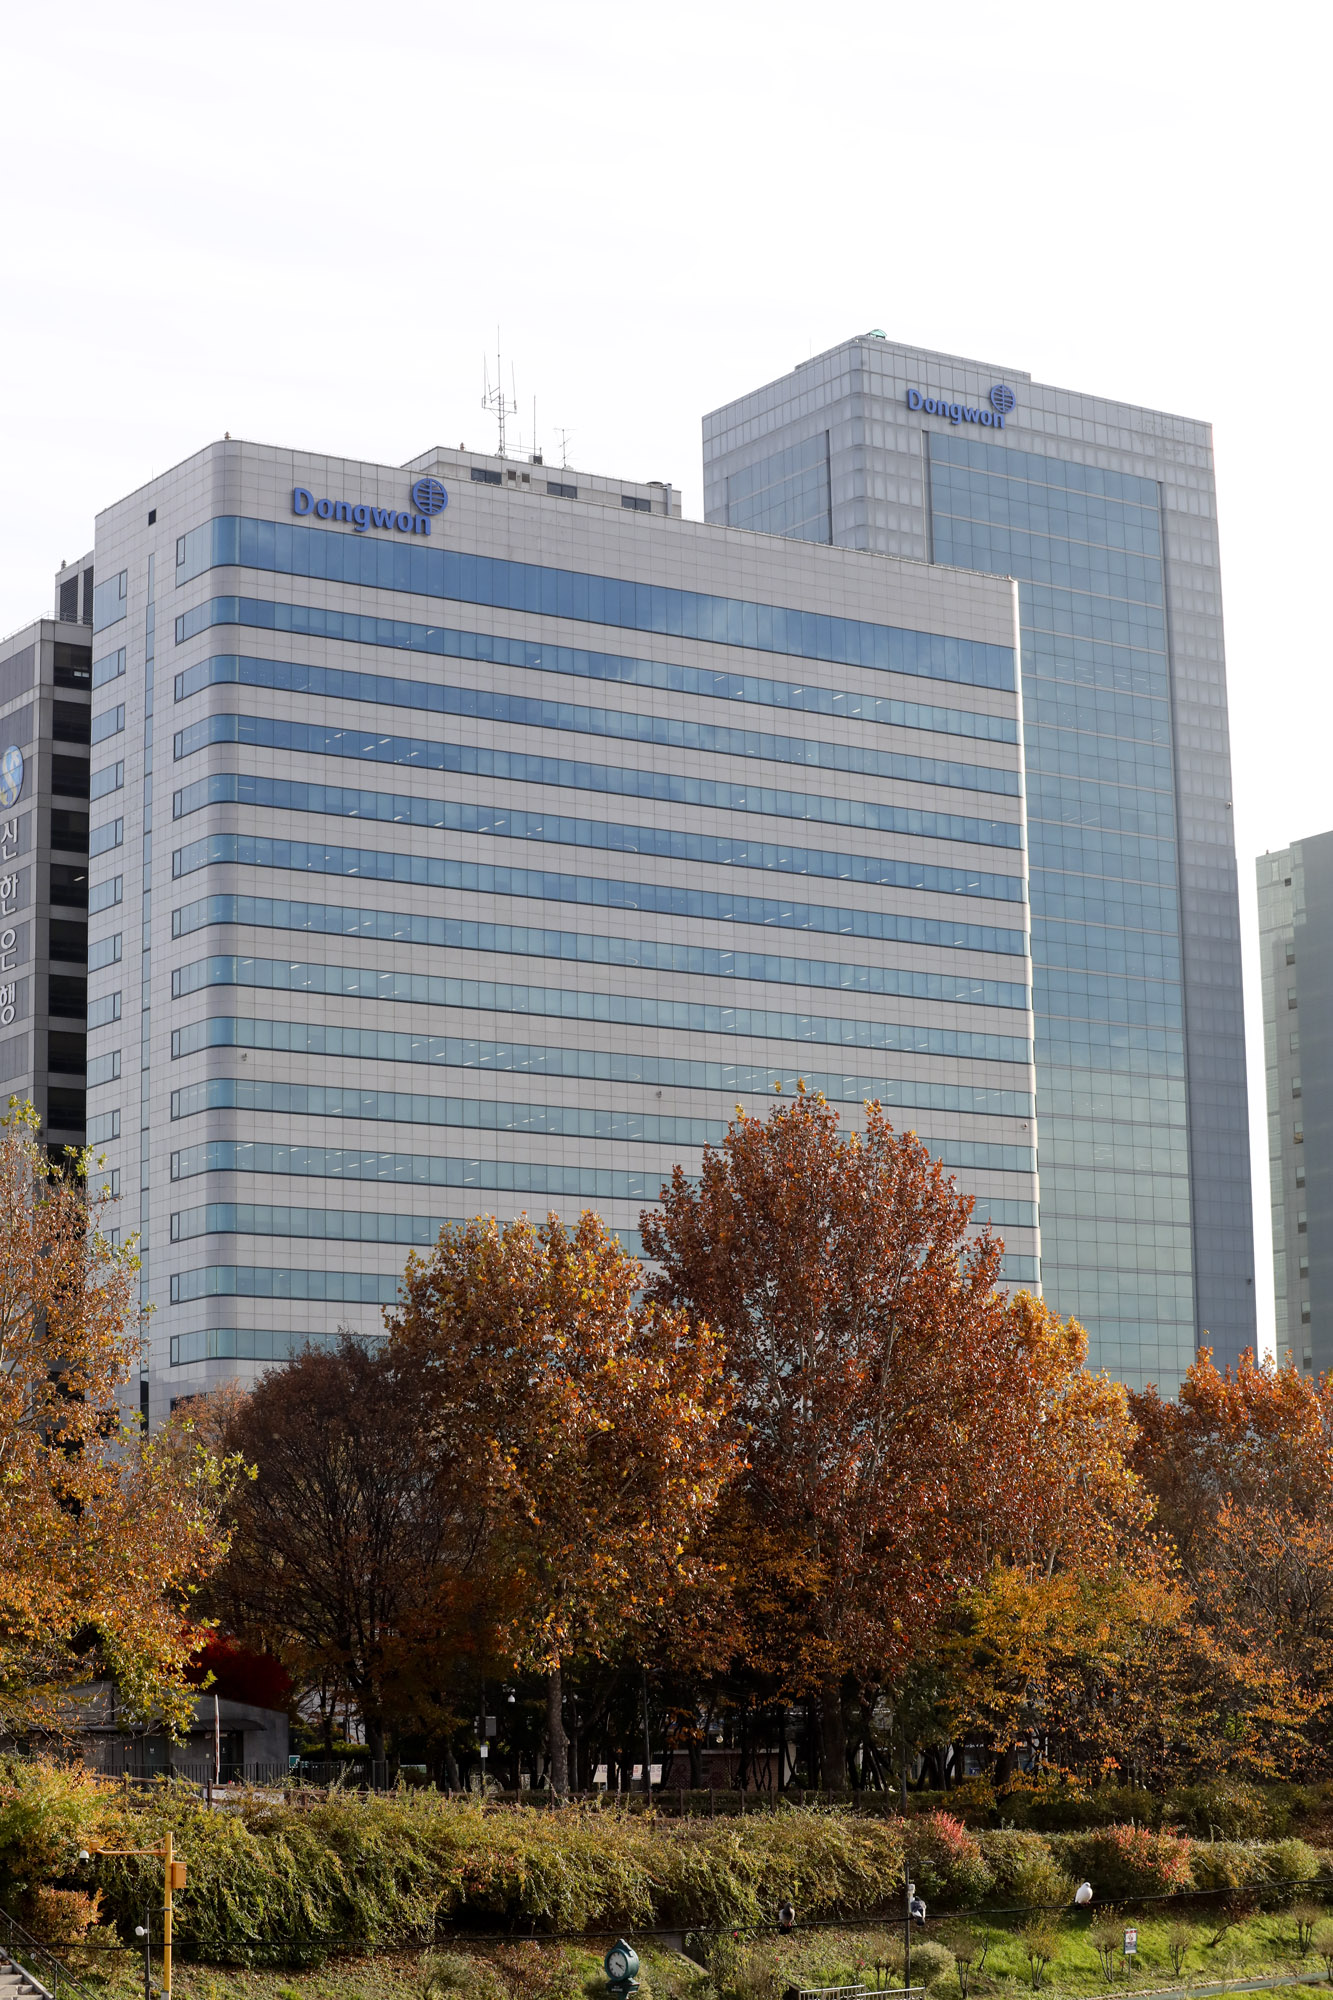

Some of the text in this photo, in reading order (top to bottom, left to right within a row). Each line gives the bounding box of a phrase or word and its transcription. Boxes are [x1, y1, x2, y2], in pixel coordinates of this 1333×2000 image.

[908, 388, 1005, 429] Dongwon
[293, 487, 432, 536] Dongwon
[0, 817, 18, 1025] 신한은행
